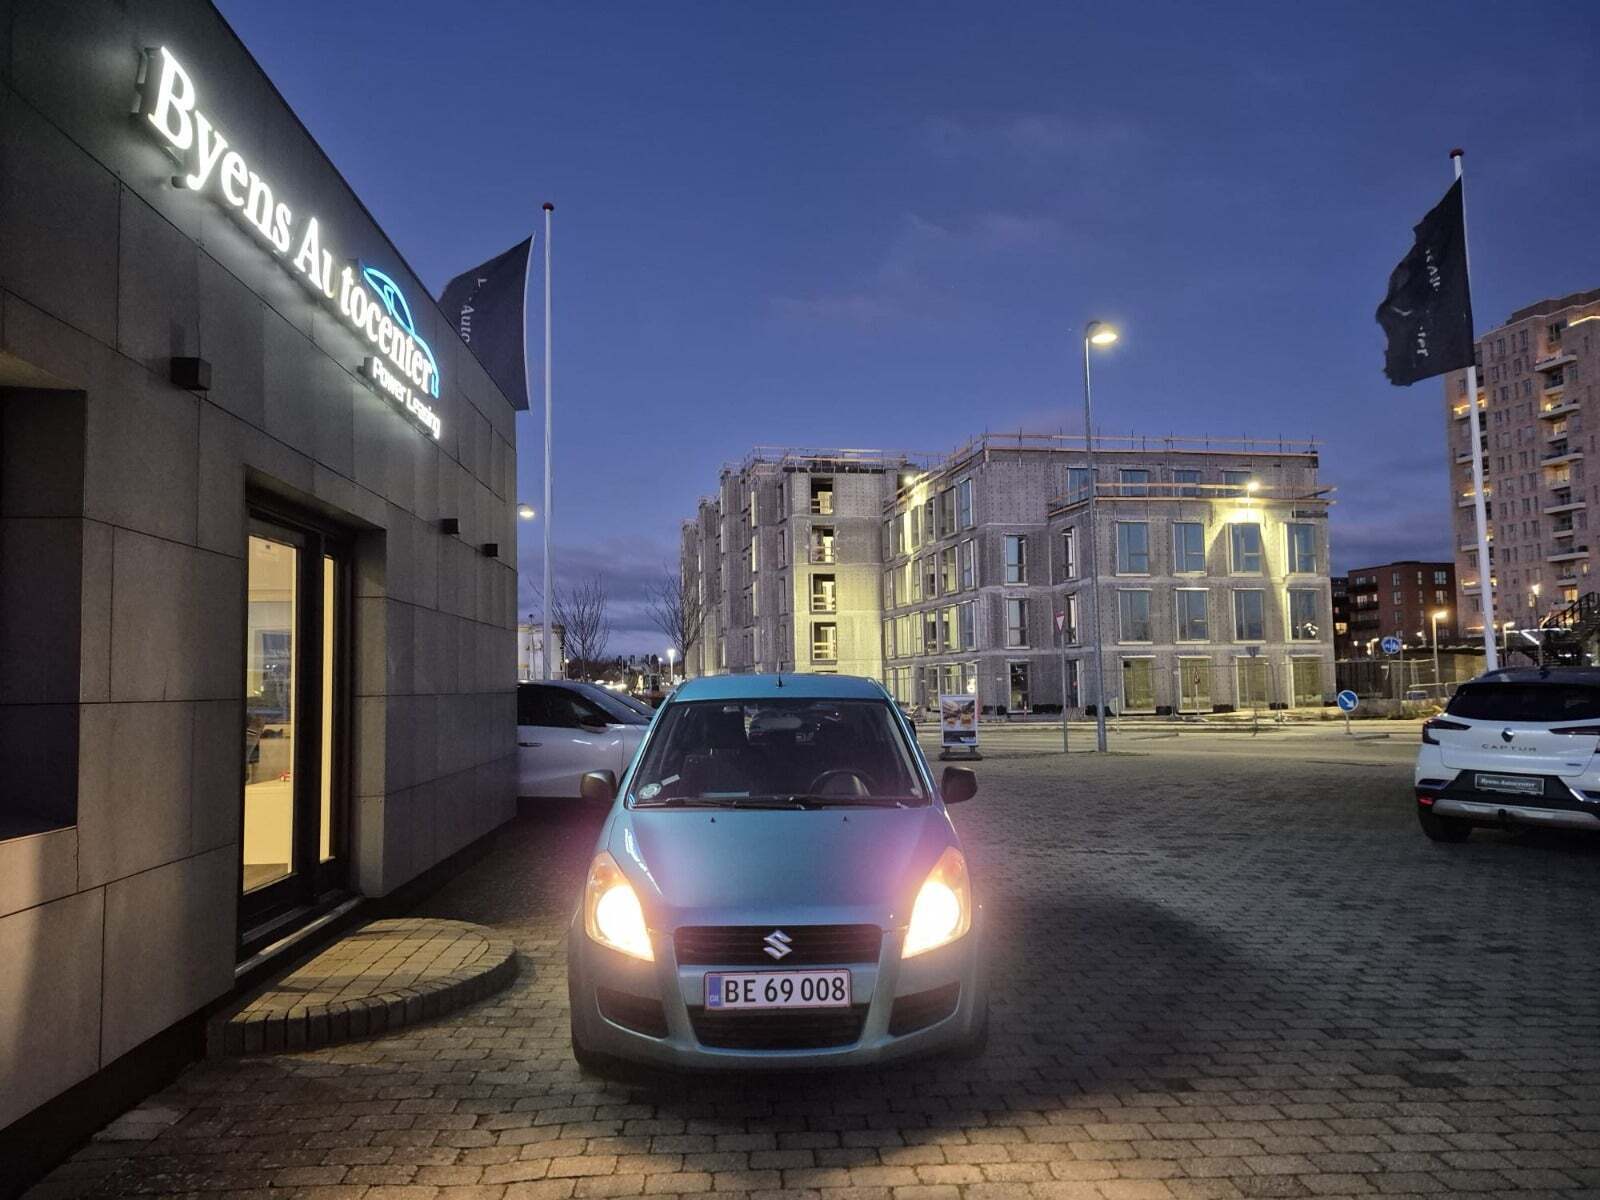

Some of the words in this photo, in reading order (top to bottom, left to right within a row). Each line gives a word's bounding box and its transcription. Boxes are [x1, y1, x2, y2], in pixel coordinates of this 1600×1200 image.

[148, 46, 292, 252] Byens
[293, 217, 433, 394] Autocenter
[372, 356, 406, 403] Power
[1480, 743, 1537, 753] CAPTUR
[725, 979, 756, 1003] BE
[764, 978, 794, 1003] 69
[801, 977, 846, 1001] 008
